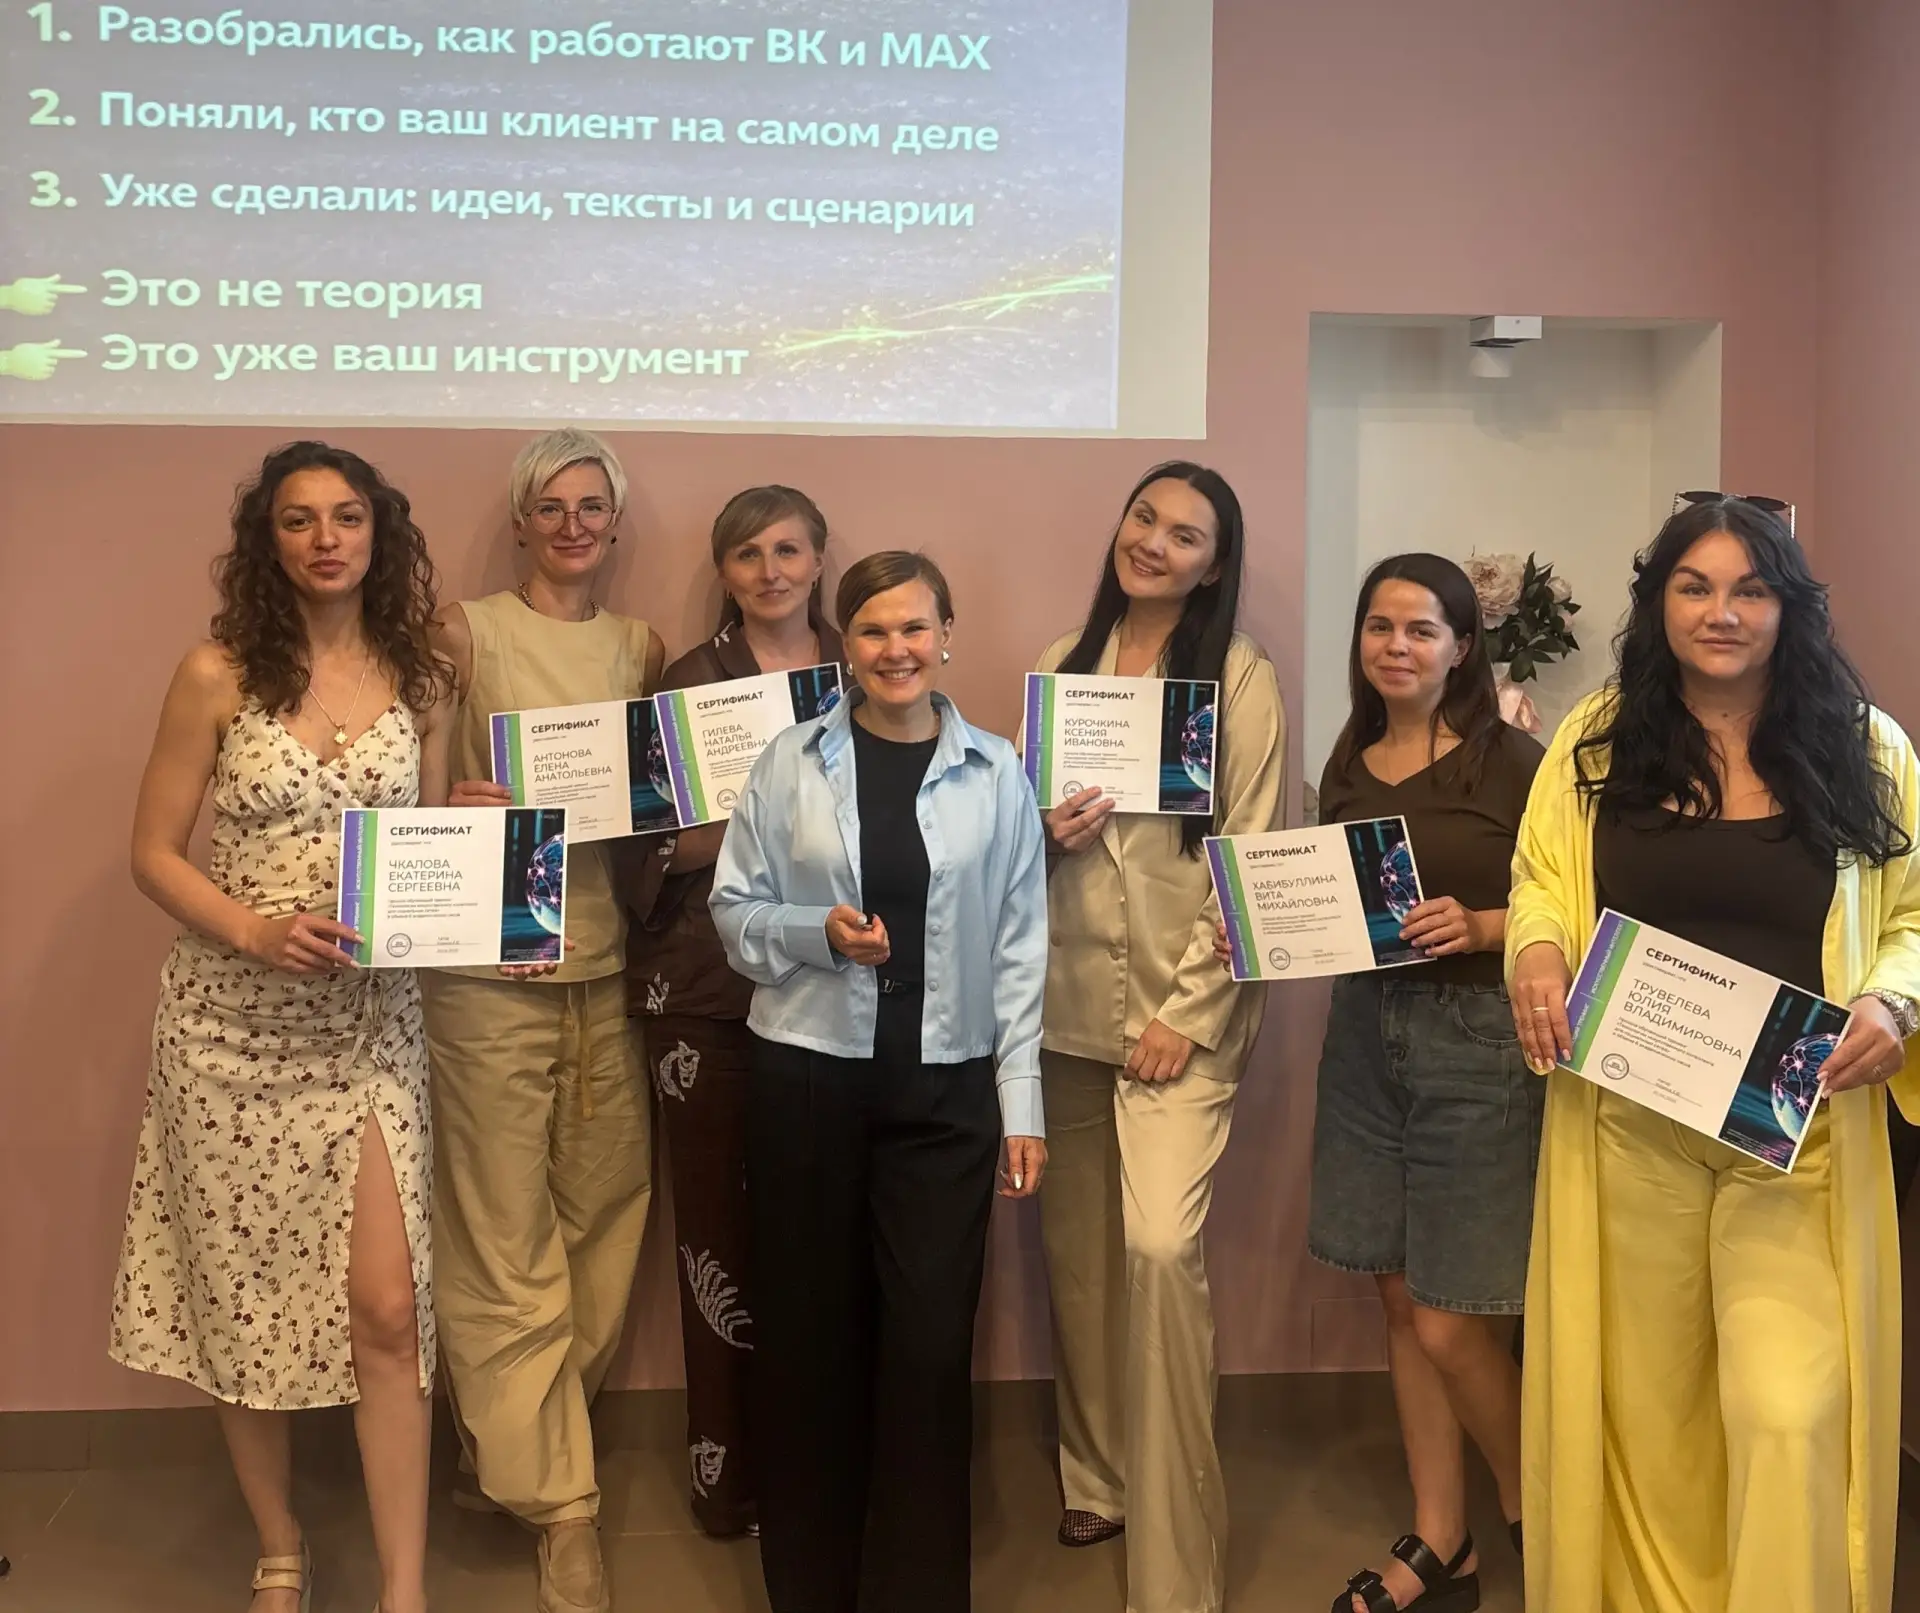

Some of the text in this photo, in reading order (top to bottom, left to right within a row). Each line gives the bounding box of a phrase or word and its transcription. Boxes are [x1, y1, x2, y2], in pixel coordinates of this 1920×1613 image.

[28, 2, 992, 70] 1. Разобрались, как работают ВК и MAX
[29, 89, 999, 154] 2. Поняли, кто ваш клиент на самом деле
[30, 171, 974, 232] 3. Уже сделали: идеи, тексты и сценарии
[101, 269, 482, 317] Это не теория
[101, 333, 749, 383] Это уже ваш инструмент
[696, 691, 764, 710] СЕРТИФИКАТ
[1065, 690, 1135, 700] СЕРТИФИКАТ
[531, 718, 600, 734] СЕРТИФИКАТ
[702, 724, 743, 739] ГИЛЕВА
[1064, 718, 1130, 729] КУРОЧКИНА
[704, 732, 752, 748] НАТАЛЬЯ
[1064, 728, 1107, 738] КСЕНИЯ
[706, 738, 768, 757] АНДРЕЕВНА
[1064, 738, 1125, 748] ИВАНОВНА
[533, 748, 592, 763] АНТОНОВА
[534, 761, 570, 773] ЕЛЕНА
[534, 765, 613, 783] АНАТОЛЬЕВНА
[390, 825, 472, 836] СЕРТИФИКАТ
[1245, 845, 1318, 860] СЕРТИФИКАТ
[389, 859, 450, 869] ЧКАЛОВА
[389, 870, 463, 881] ЕКАТЕРИНА
[1252, 874, 1337, 891] ХАБИБУЛЛИНА
[388, 881, 461, 893] СЕРГЕЕВНА
[1255, 891, 1284, 901] ВИТА
[1256, 895, 1338, 912] МИХАЙЛОВНА
[1646, 947, 1737, 991] СЕРТИФИКАТ
[1628, 990, 1672, 1016] ЮЛИЯ
[1633, 978, 1711, 1020] ТРУВЕЛЕВА
[1623, 1002, 1743, 1060] ВЛАДИМИРОВНА
